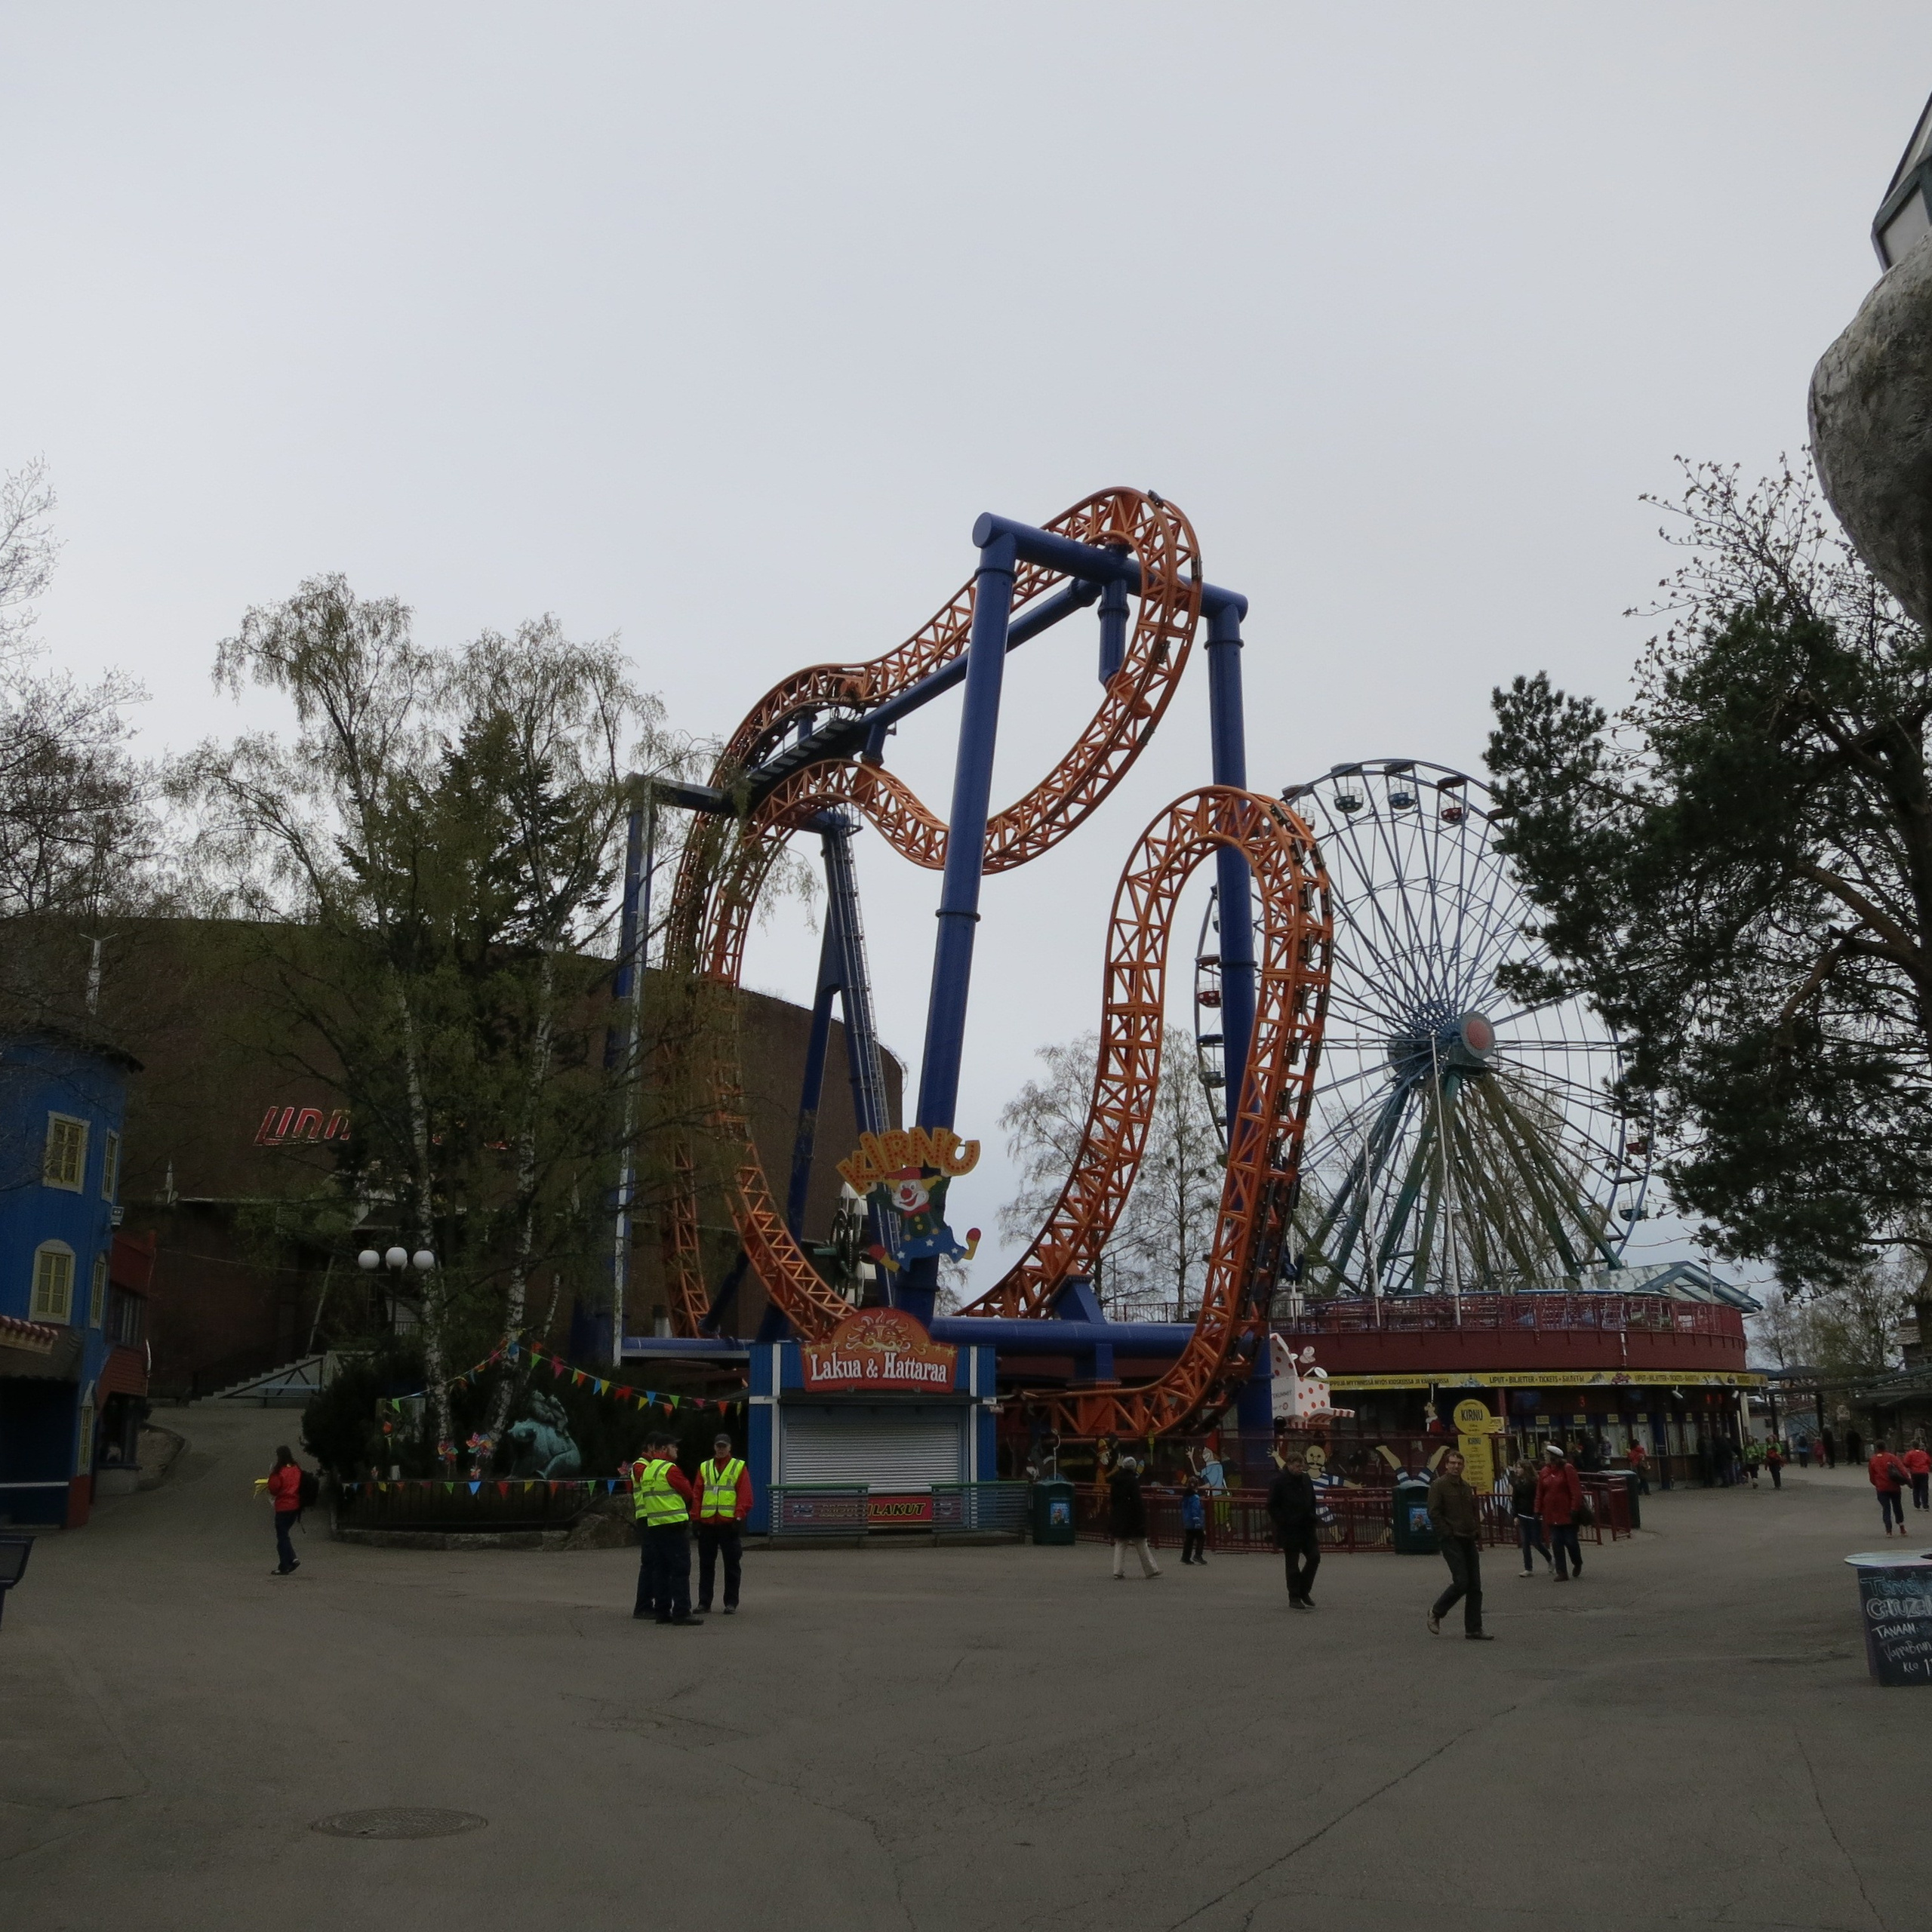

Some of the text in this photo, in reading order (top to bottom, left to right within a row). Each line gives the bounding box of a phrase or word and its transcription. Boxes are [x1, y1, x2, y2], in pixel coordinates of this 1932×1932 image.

[836, 1127, 980, 1196] KIRNU
[810, 1352, 947, 1383] Lakua & Hattaraa
[1461, 1409, 1483, 1421] KIRNU
